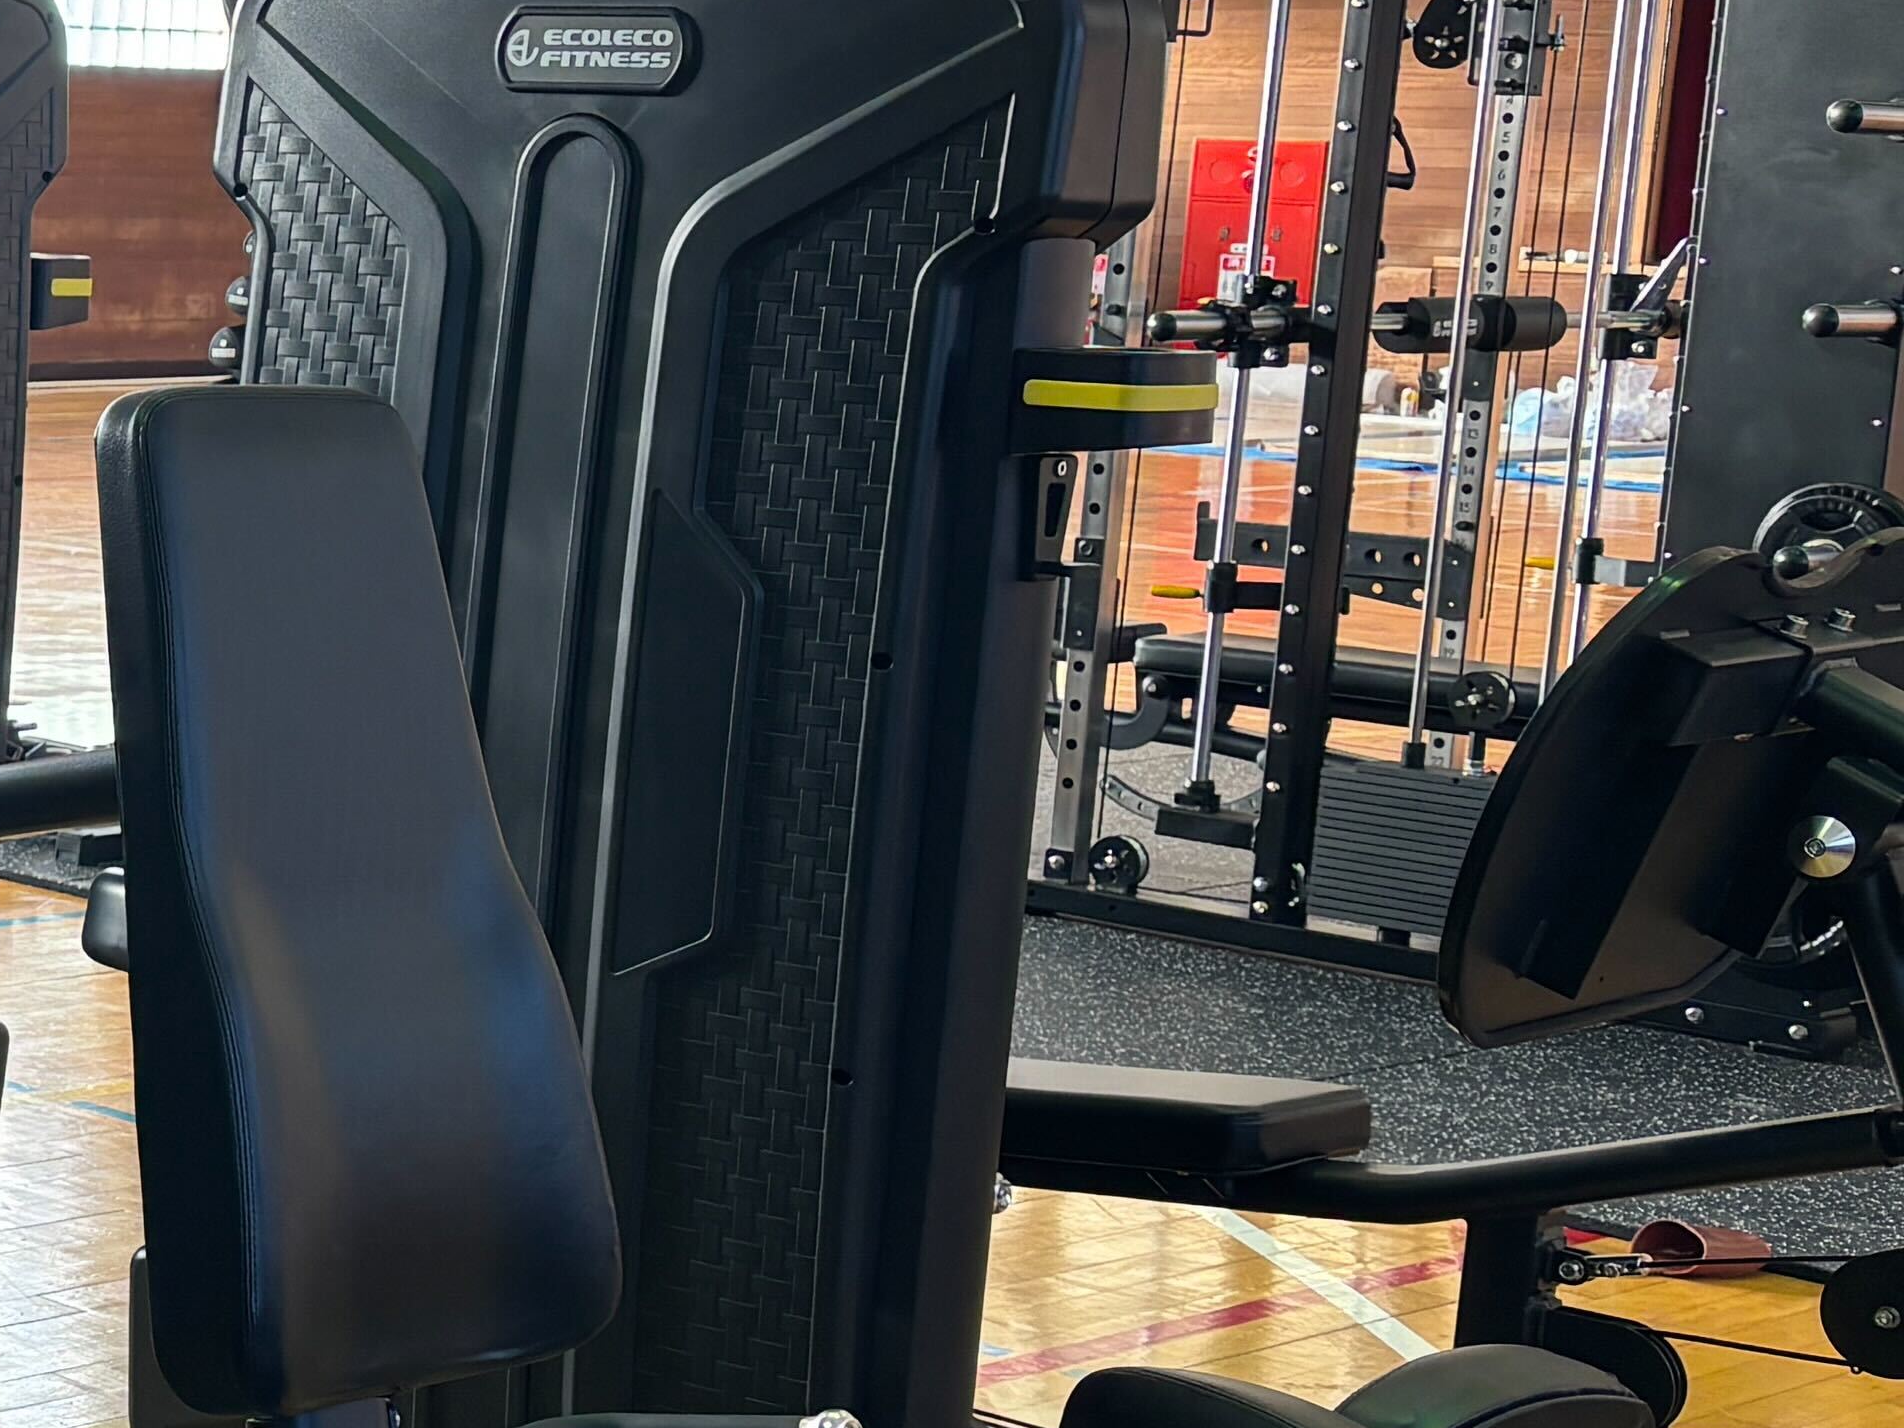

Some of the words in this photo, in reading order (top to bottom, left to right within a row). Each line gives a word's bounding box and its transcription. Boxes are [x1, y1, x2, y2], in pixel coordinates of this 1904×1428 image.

[540, 50, 672, 69] FITNESS
[1501, 131, 1512, 143] 5
[1497, 170, 1506, 181] 6
[1493, 206, 1502, 218] 7
